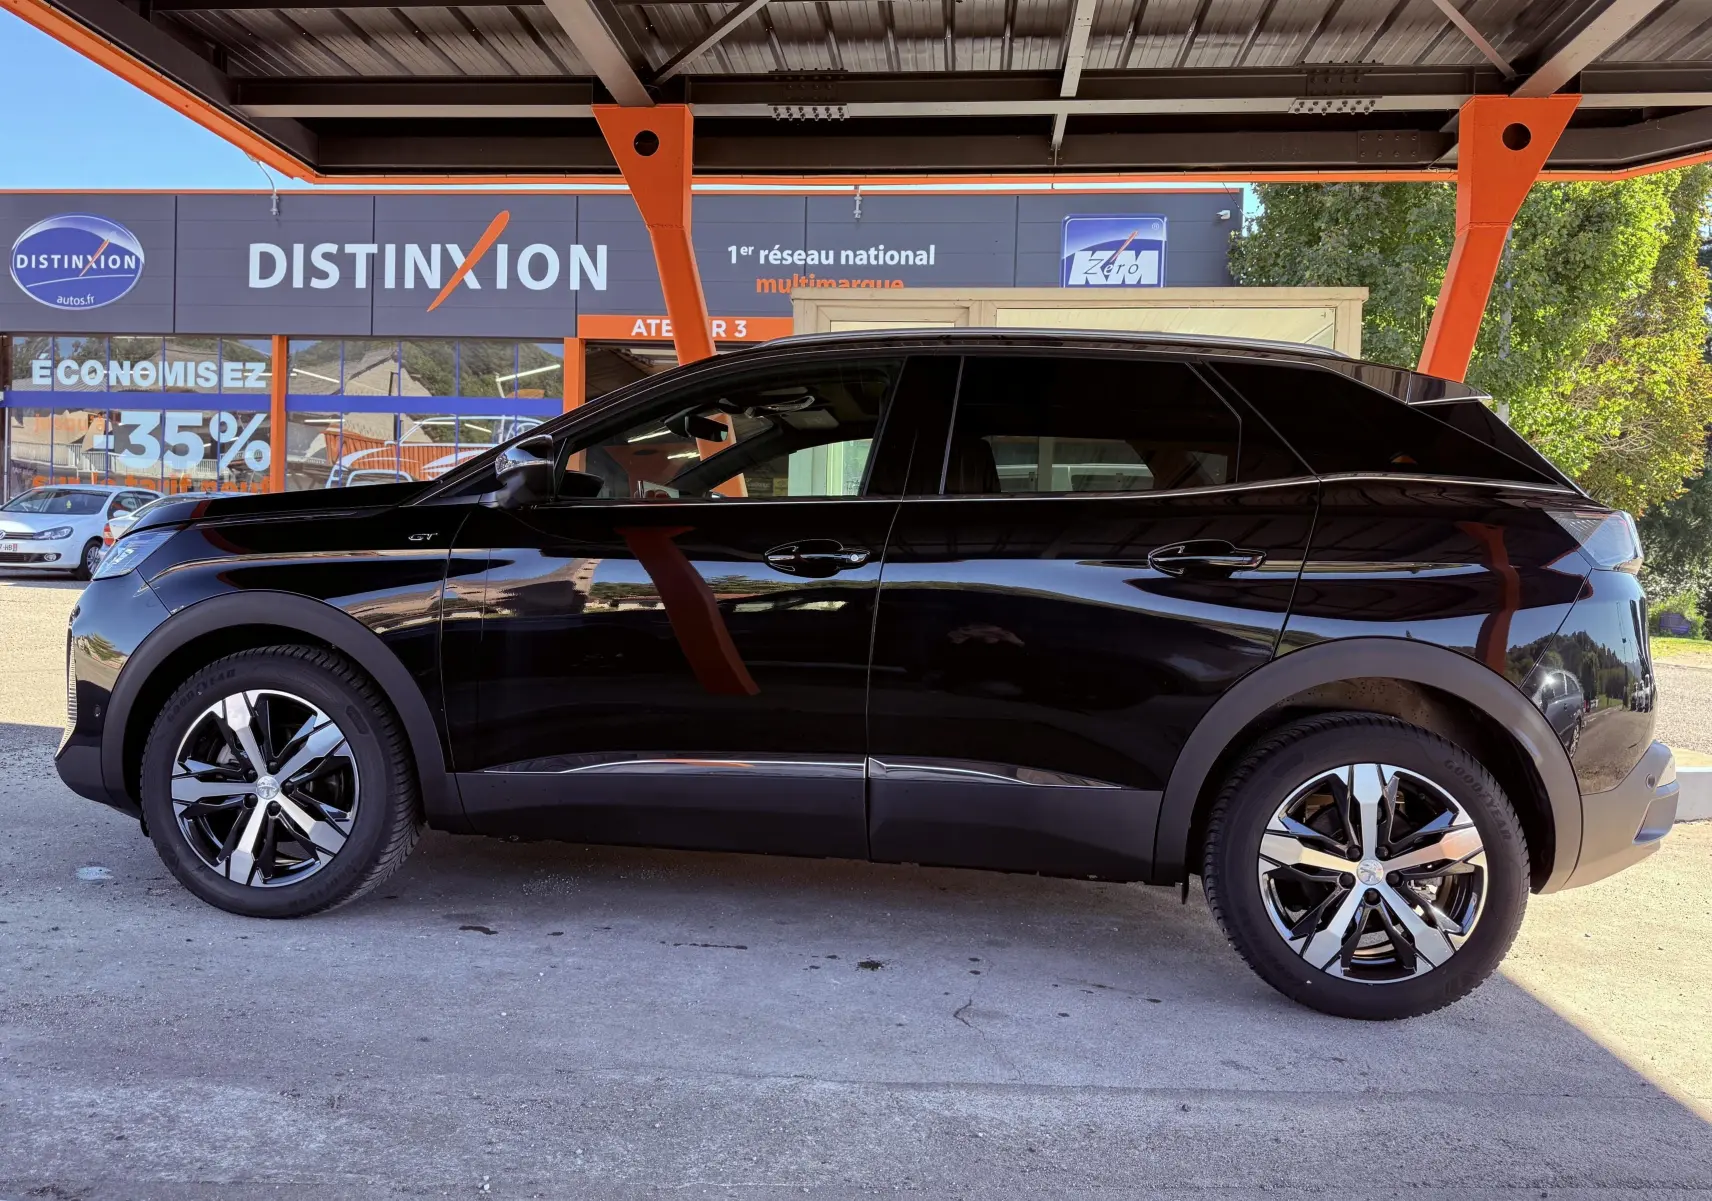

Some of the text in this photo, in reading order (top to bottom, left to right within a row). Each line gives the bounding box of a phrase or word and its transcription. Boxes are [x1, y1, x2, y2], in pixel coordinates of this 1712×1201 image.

[728, 245, 935, 265] 1er réseau national
[1068, 250, 1159, 285] KM
[56, 293, 95, 306] autos.fr
[631, 318, 747, 338] ATER 3
[32, 353, 267, 388] ÉCONOMISEZ
[93, 411, 271, 472] -35%
[408, 533, 438, 541] GT
